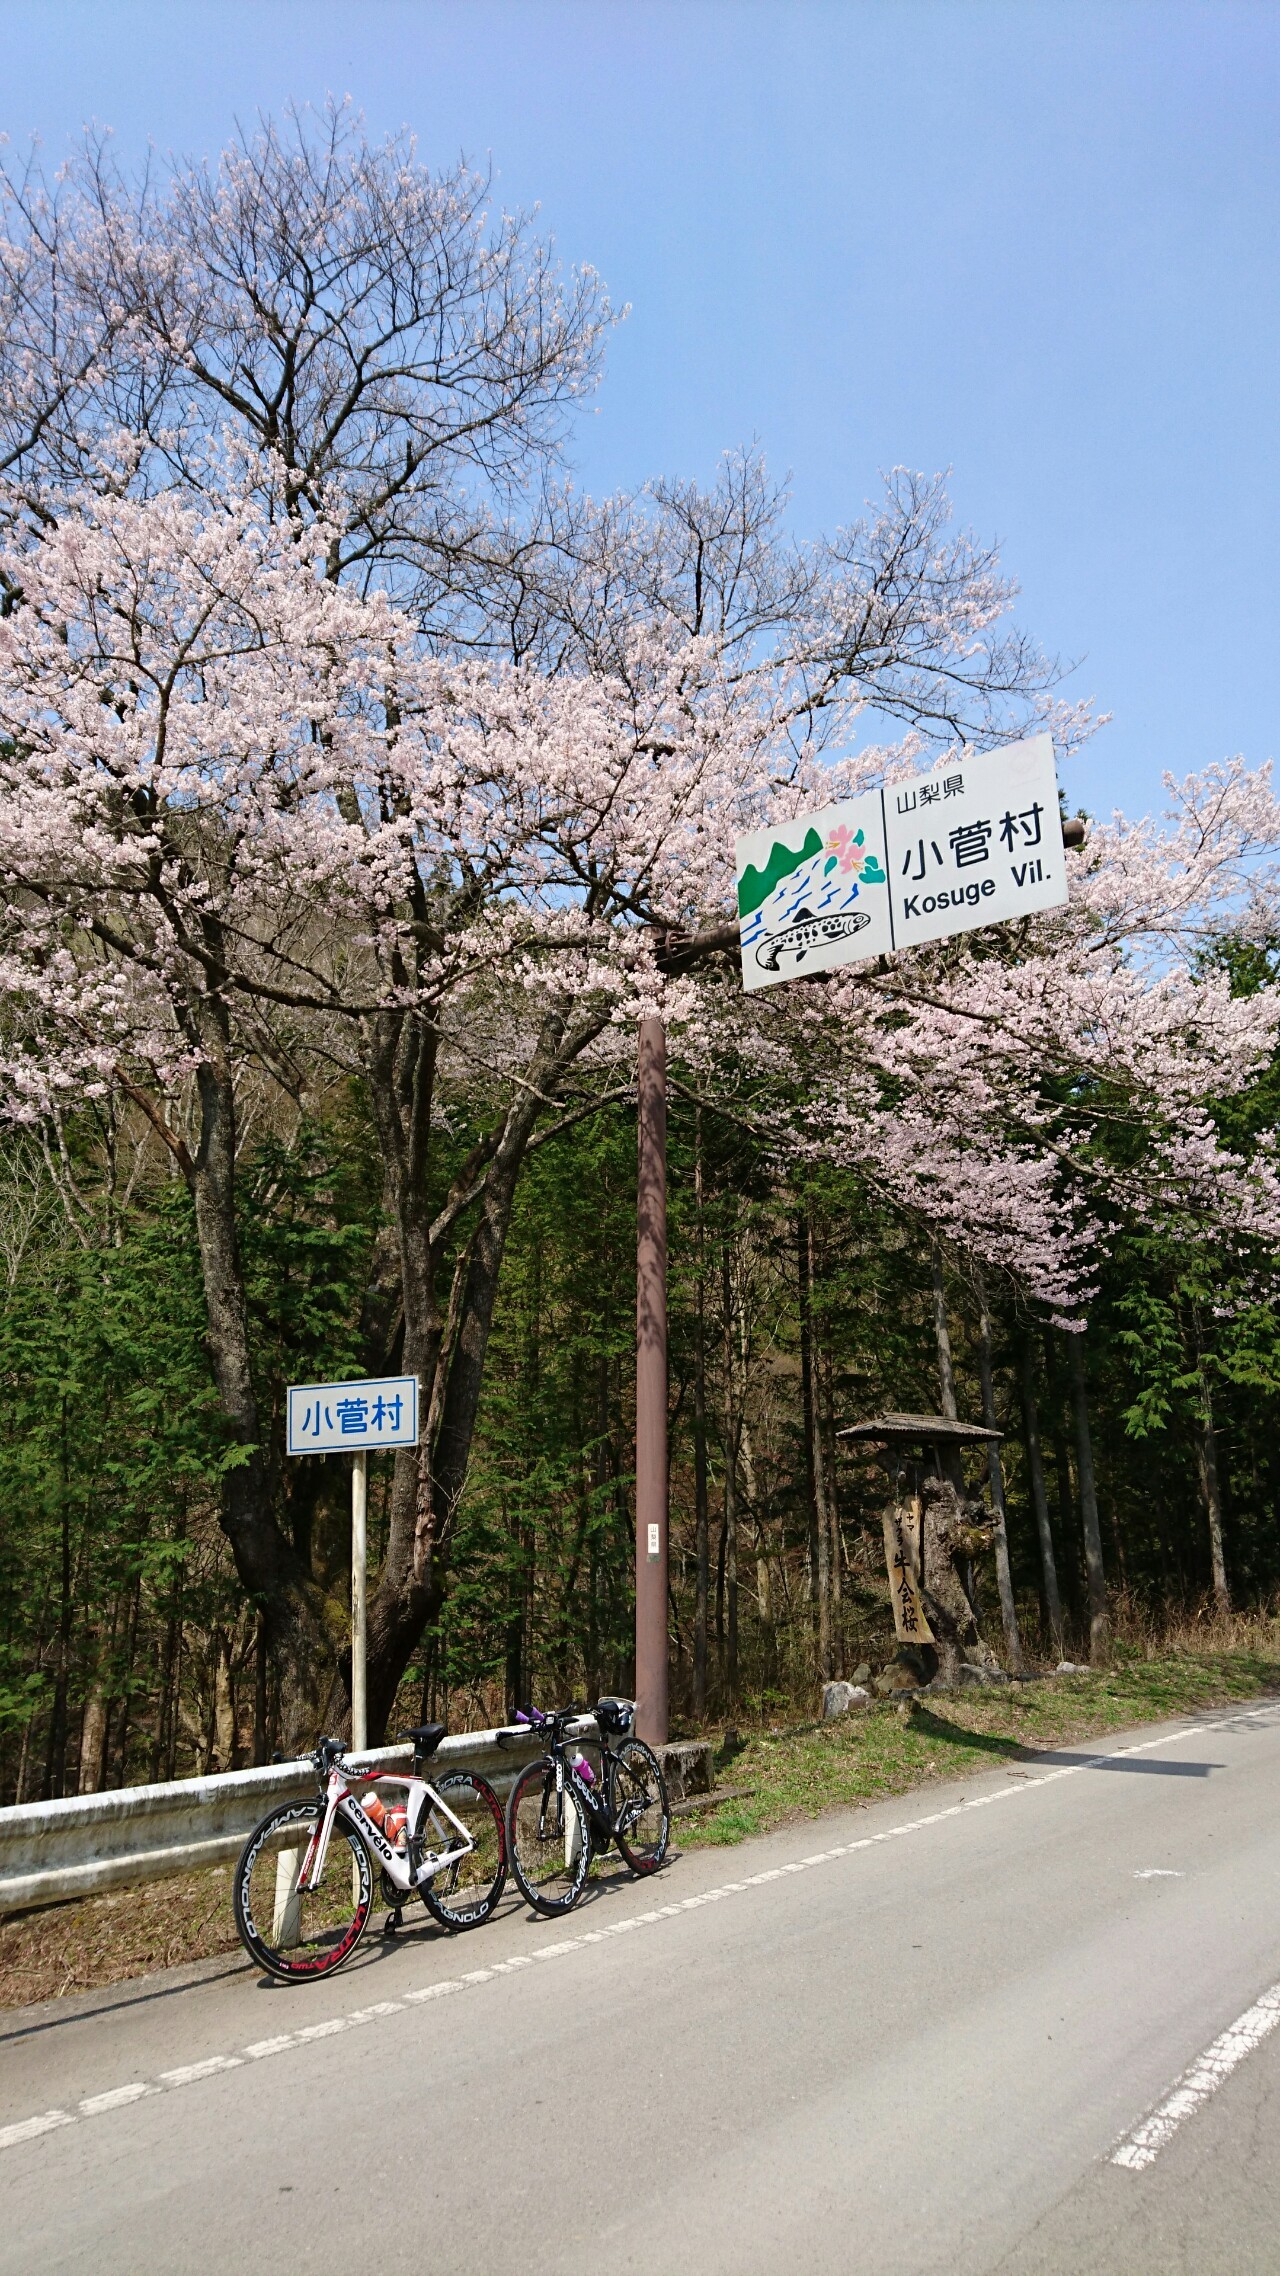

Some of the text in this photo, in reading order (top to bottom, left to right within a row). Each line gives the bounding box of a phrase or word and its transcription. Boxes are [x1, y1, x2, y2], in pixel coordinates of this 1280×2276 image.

[897, 774, 965, 814] 山梨県
[902, 802, 1044, 880] 小菅村
[904, 859, 1051, 919] Kosuge Vil.
[302, 1394, 404, 1437] 小菅村
[241, 1806, 318, 1939] CAMPAGNOLO
[347, 1834, 369, 1905] BORA
[428, 1889, 489, 1923] PAGNOLO
